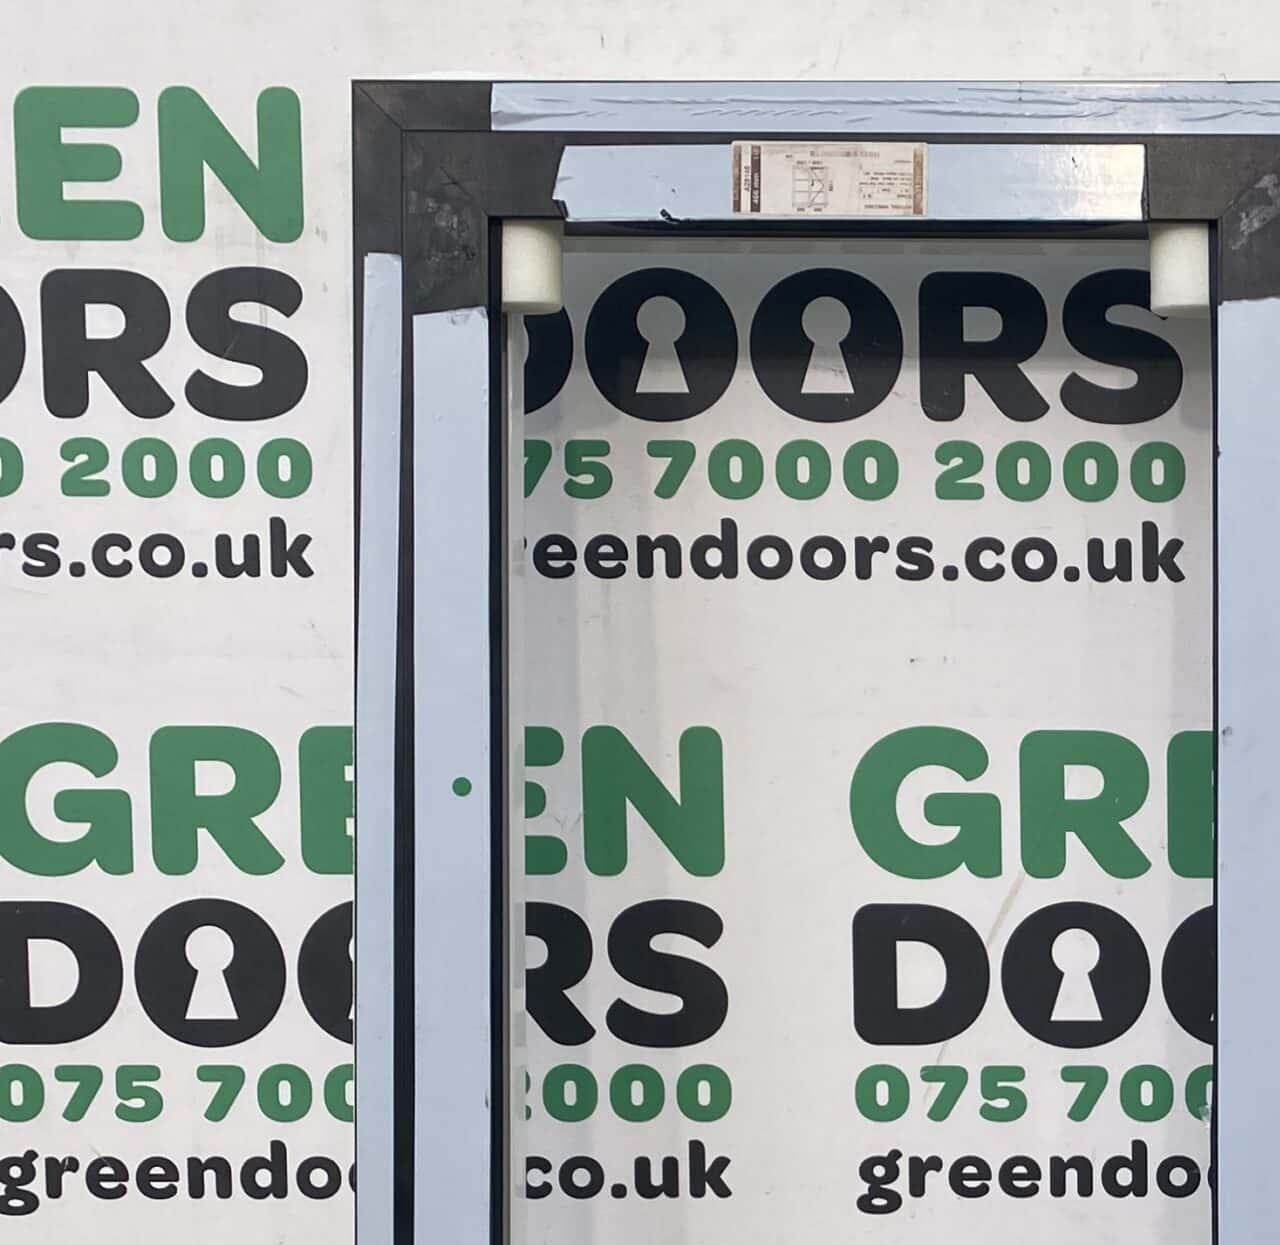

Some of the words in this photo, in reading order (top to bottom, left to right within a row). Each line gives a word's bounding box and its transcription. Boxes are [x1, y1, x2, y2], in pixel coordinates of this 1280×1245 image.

[0, 266, 310, 422] RS
[60, 437, 313, 499] 2000
[646, 439, 899, 501] 7000
[935, 440, 1186, 503] 2000
[524, 517, 1186, 583] eendoors.co.uk
[0, 1064, 163, 1123] 075
[524, 1063, 732, 1123] 000
[855, 1064, 1028, 1123] 075
